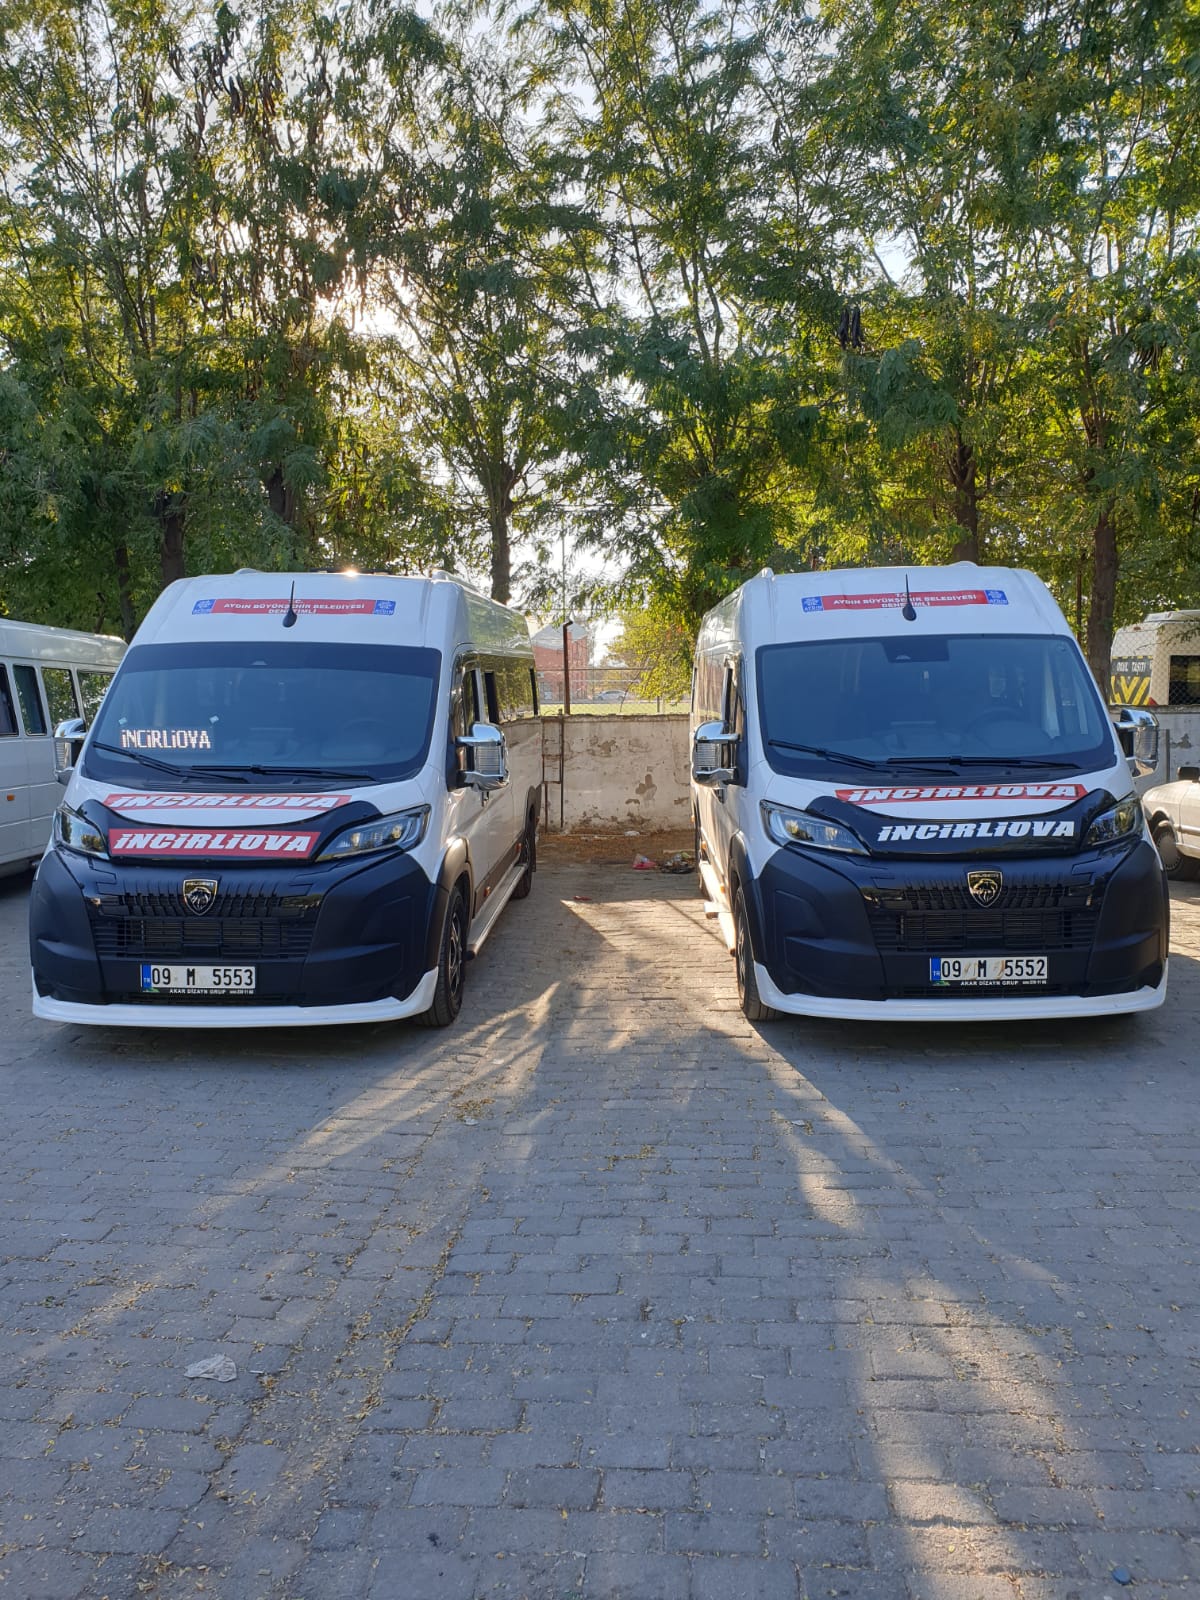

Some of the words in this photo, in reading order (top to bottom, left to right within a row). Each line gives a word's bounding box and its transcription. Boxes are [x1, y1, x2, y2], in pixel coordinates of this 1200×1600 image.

[152, 967, 171, 985] 09
[186, 967, 196, 986] M
[212, 968, 253, 986] 5553
[941, 960, 962, 978] 09
[977, 960, 987, 977] M
[1005, 959, 1046, 977] 5552
